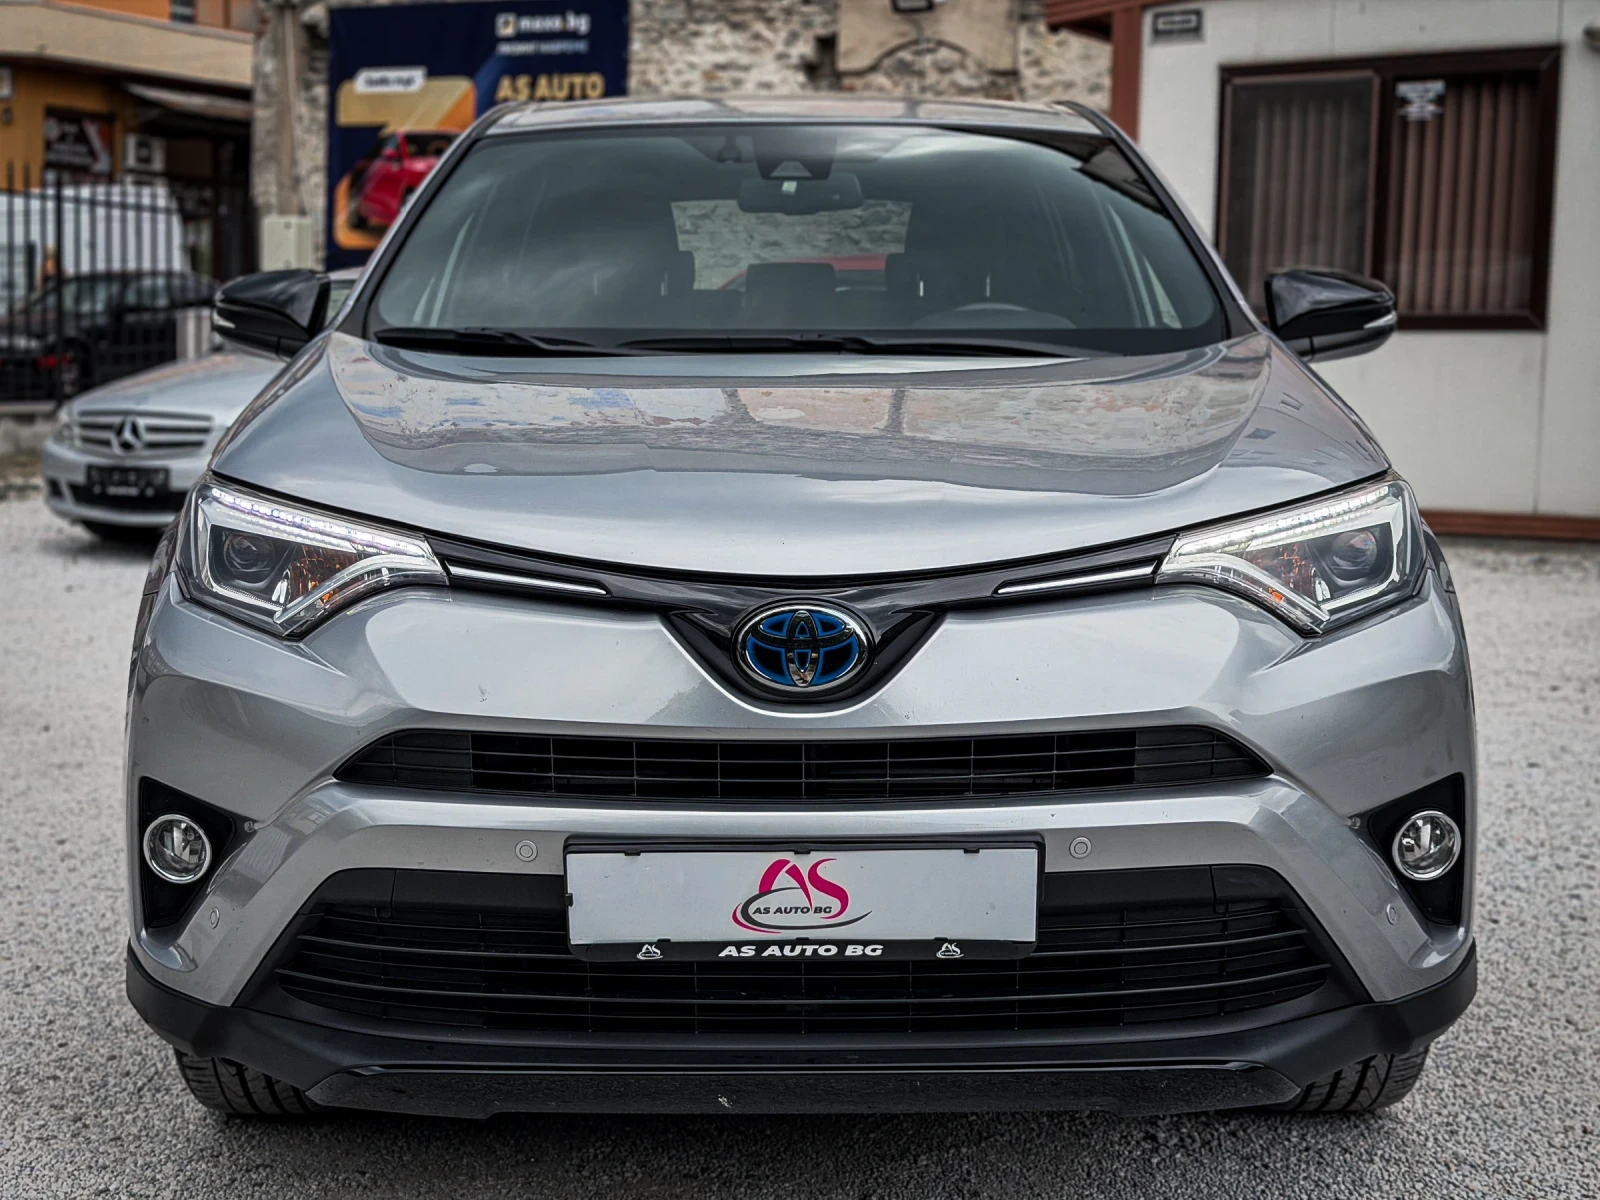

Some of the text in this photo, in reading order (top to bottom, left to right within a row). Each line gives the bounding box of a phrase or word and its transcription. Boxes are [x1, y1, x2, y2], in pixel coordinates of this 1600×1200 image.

[496, 73, 605, 101] AS AUTO
[759, 858, 849, 919] AS
[752, 906, 832, 915] AS AUTO BG
[718, 945, 884, 957] AS AUTO BG
